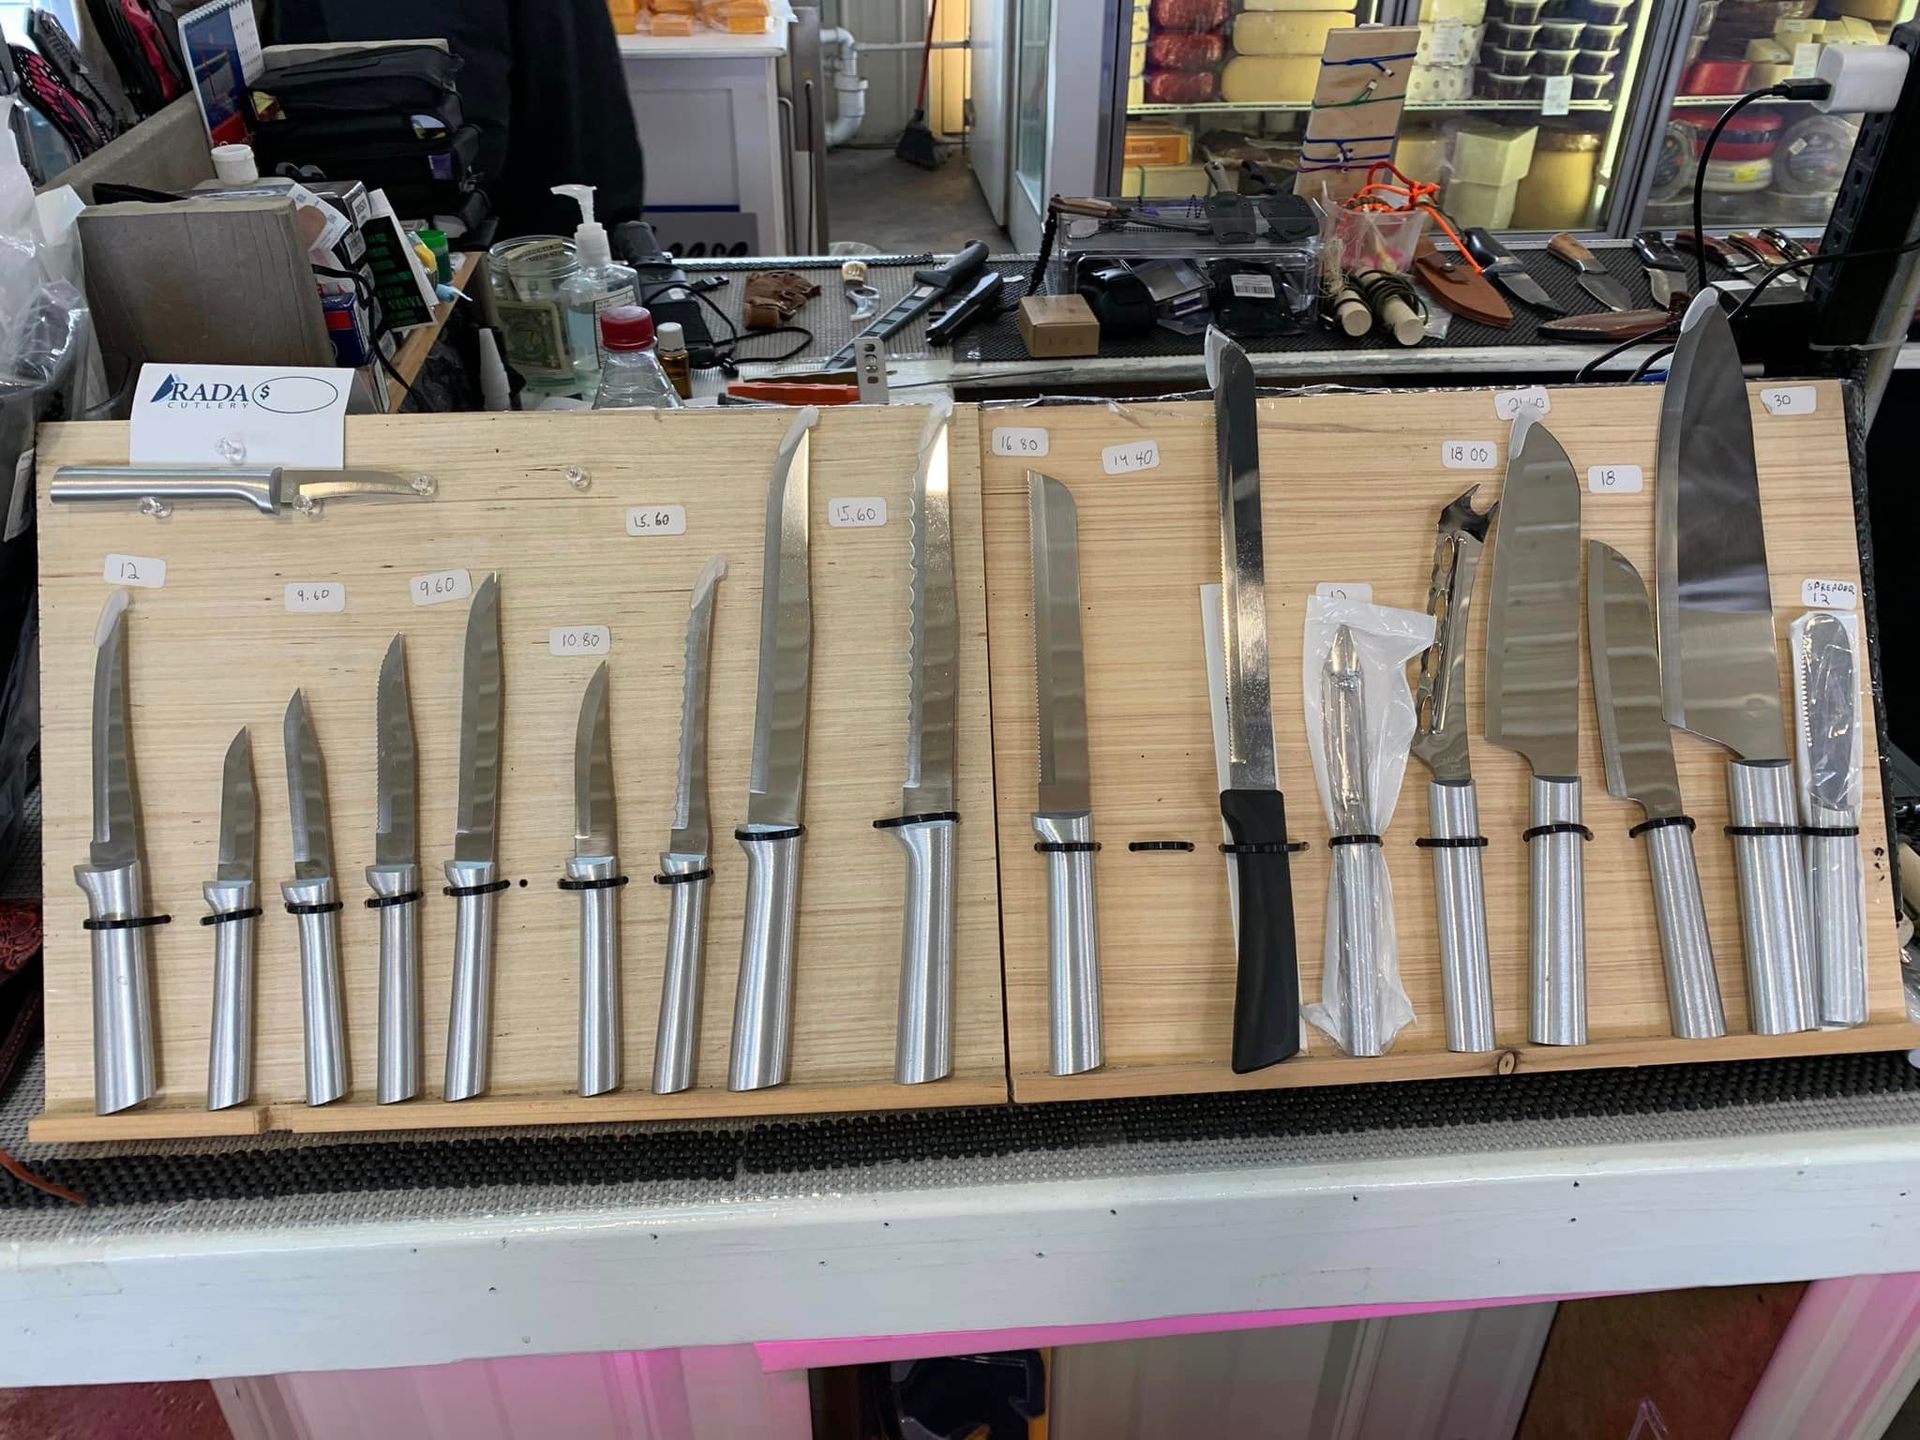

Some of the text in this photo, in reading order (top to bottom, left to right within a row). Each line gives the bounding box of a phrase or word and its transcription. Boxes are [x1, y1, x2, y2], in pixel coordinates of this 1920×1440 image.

[171, 382, 250, 402] RADA
[167, 401, 250, 409] CUTLERY
[1773, 394, 1792, 407] 30
[1600, 470, 1617, 487] 18
[119, 561, 141, 580] 12
[296, 588, 331, 603] 9.60
[1813, 593, 1831, 606] 12
